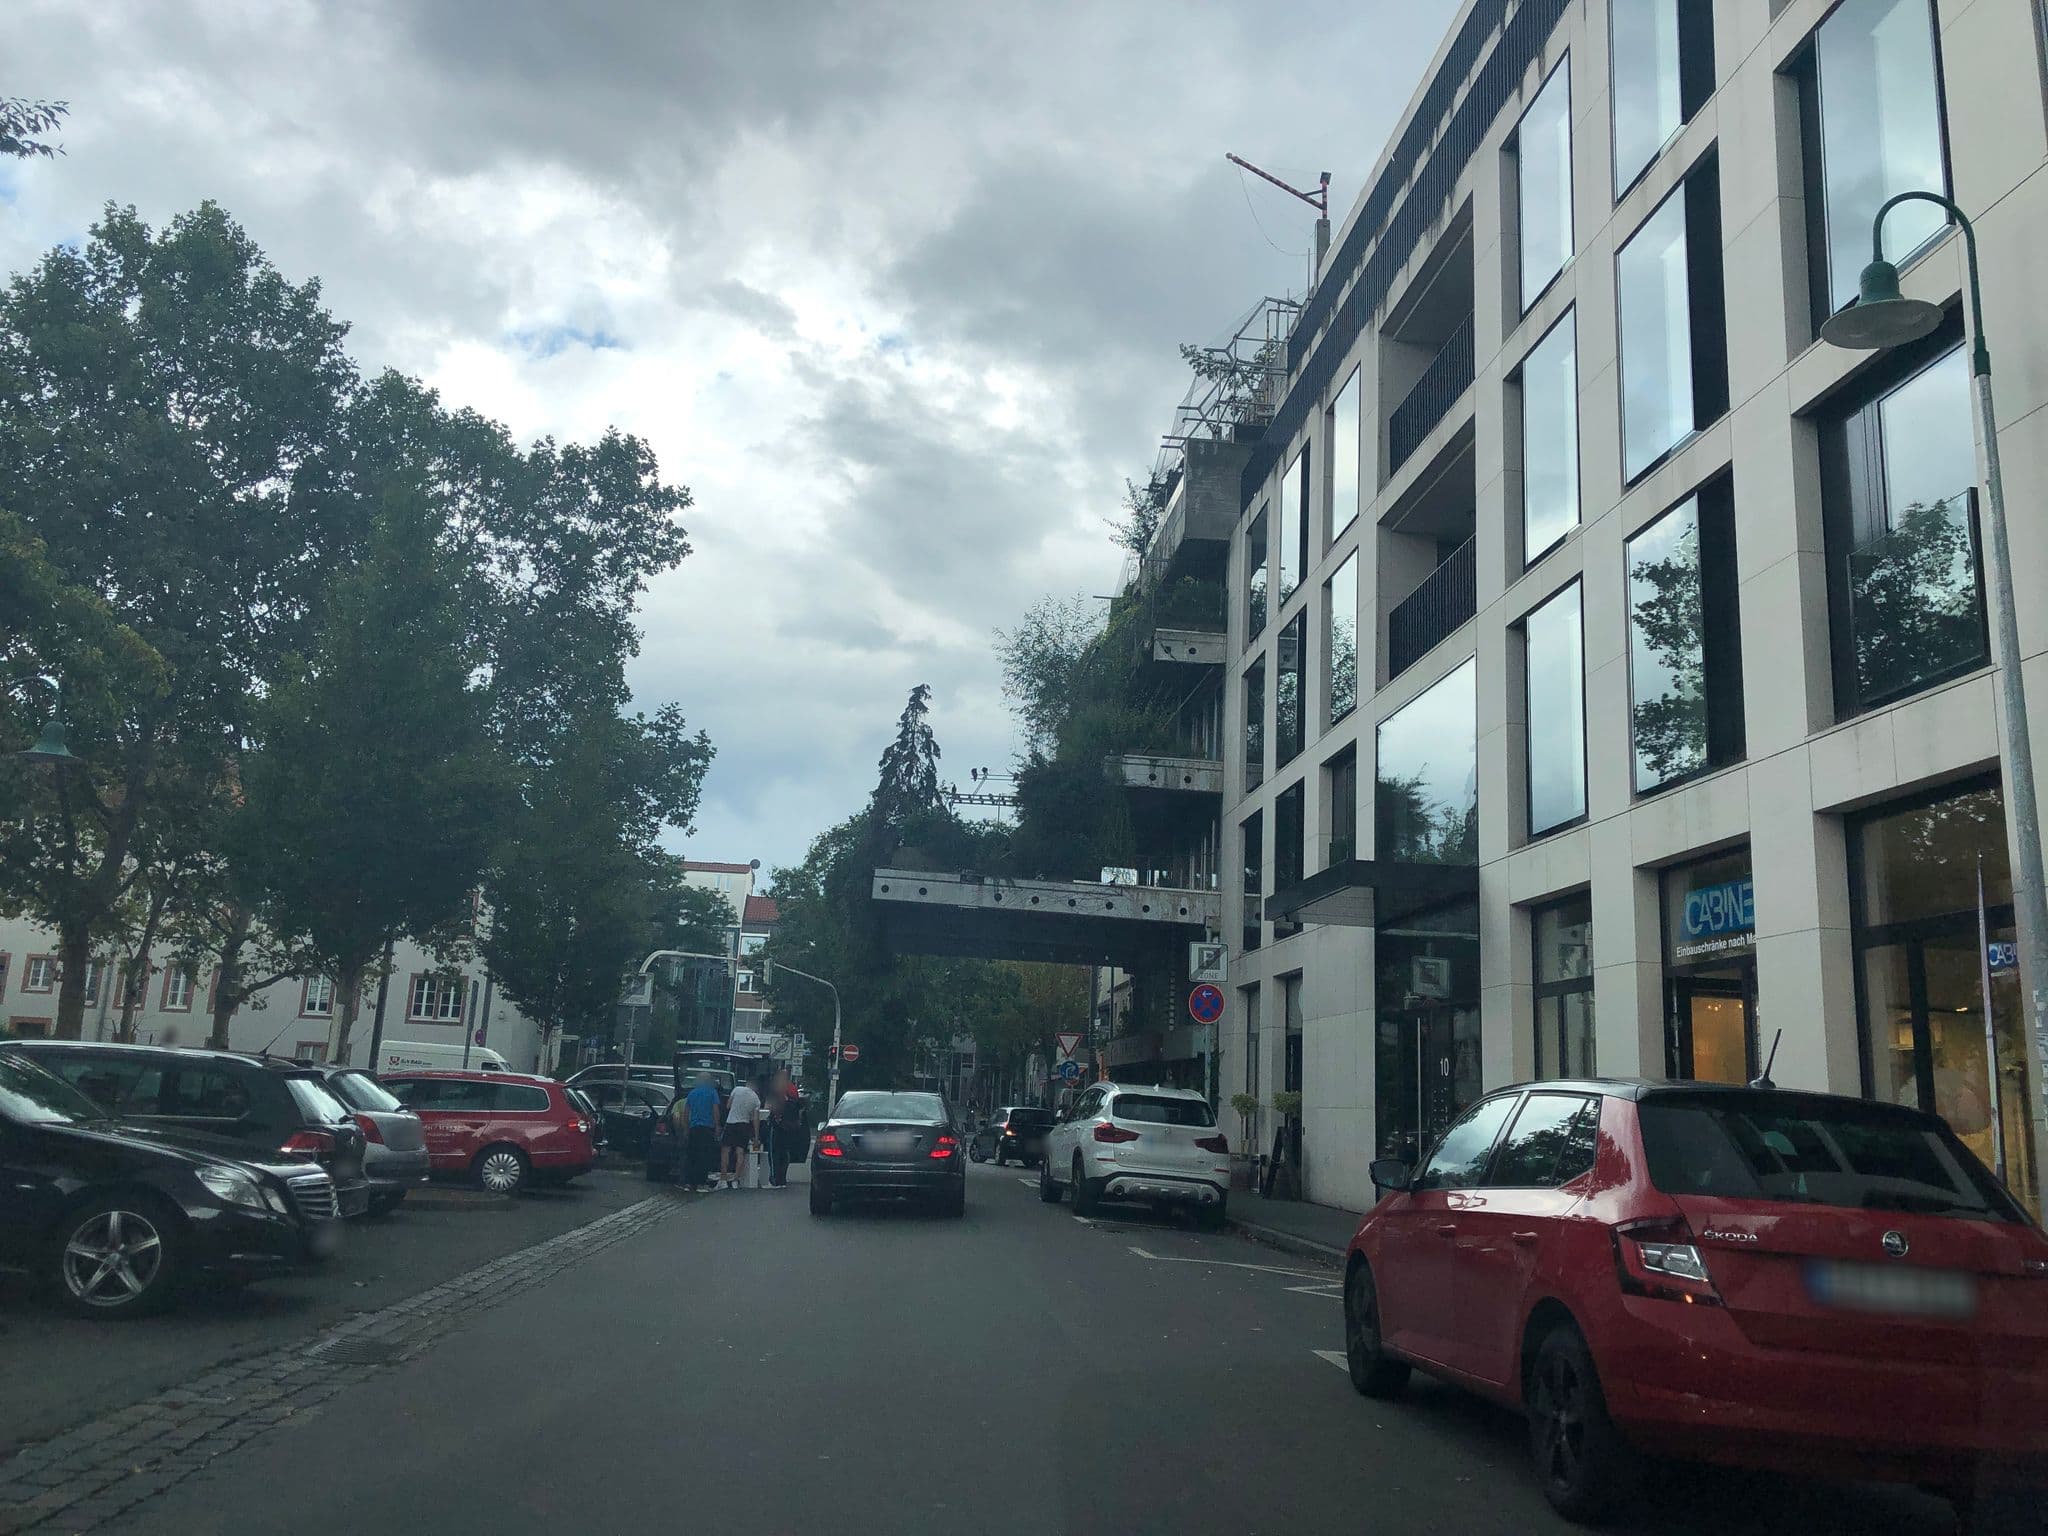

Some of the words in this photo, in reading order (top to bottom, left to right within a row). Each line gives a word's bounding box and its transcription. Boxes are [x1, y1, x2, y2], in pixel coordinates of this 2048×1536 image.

[1685, 882, 1755, 935] CABINE
[1676, 938, 1728, 958] Einbauschränke
[1728, 934, 1746, 948] nach
[1989, 943, 2017, 966] CABI
[1440, 1057, 1450, 1077] 10
[1703, 1229, 1759, 1242] ŠKODA
